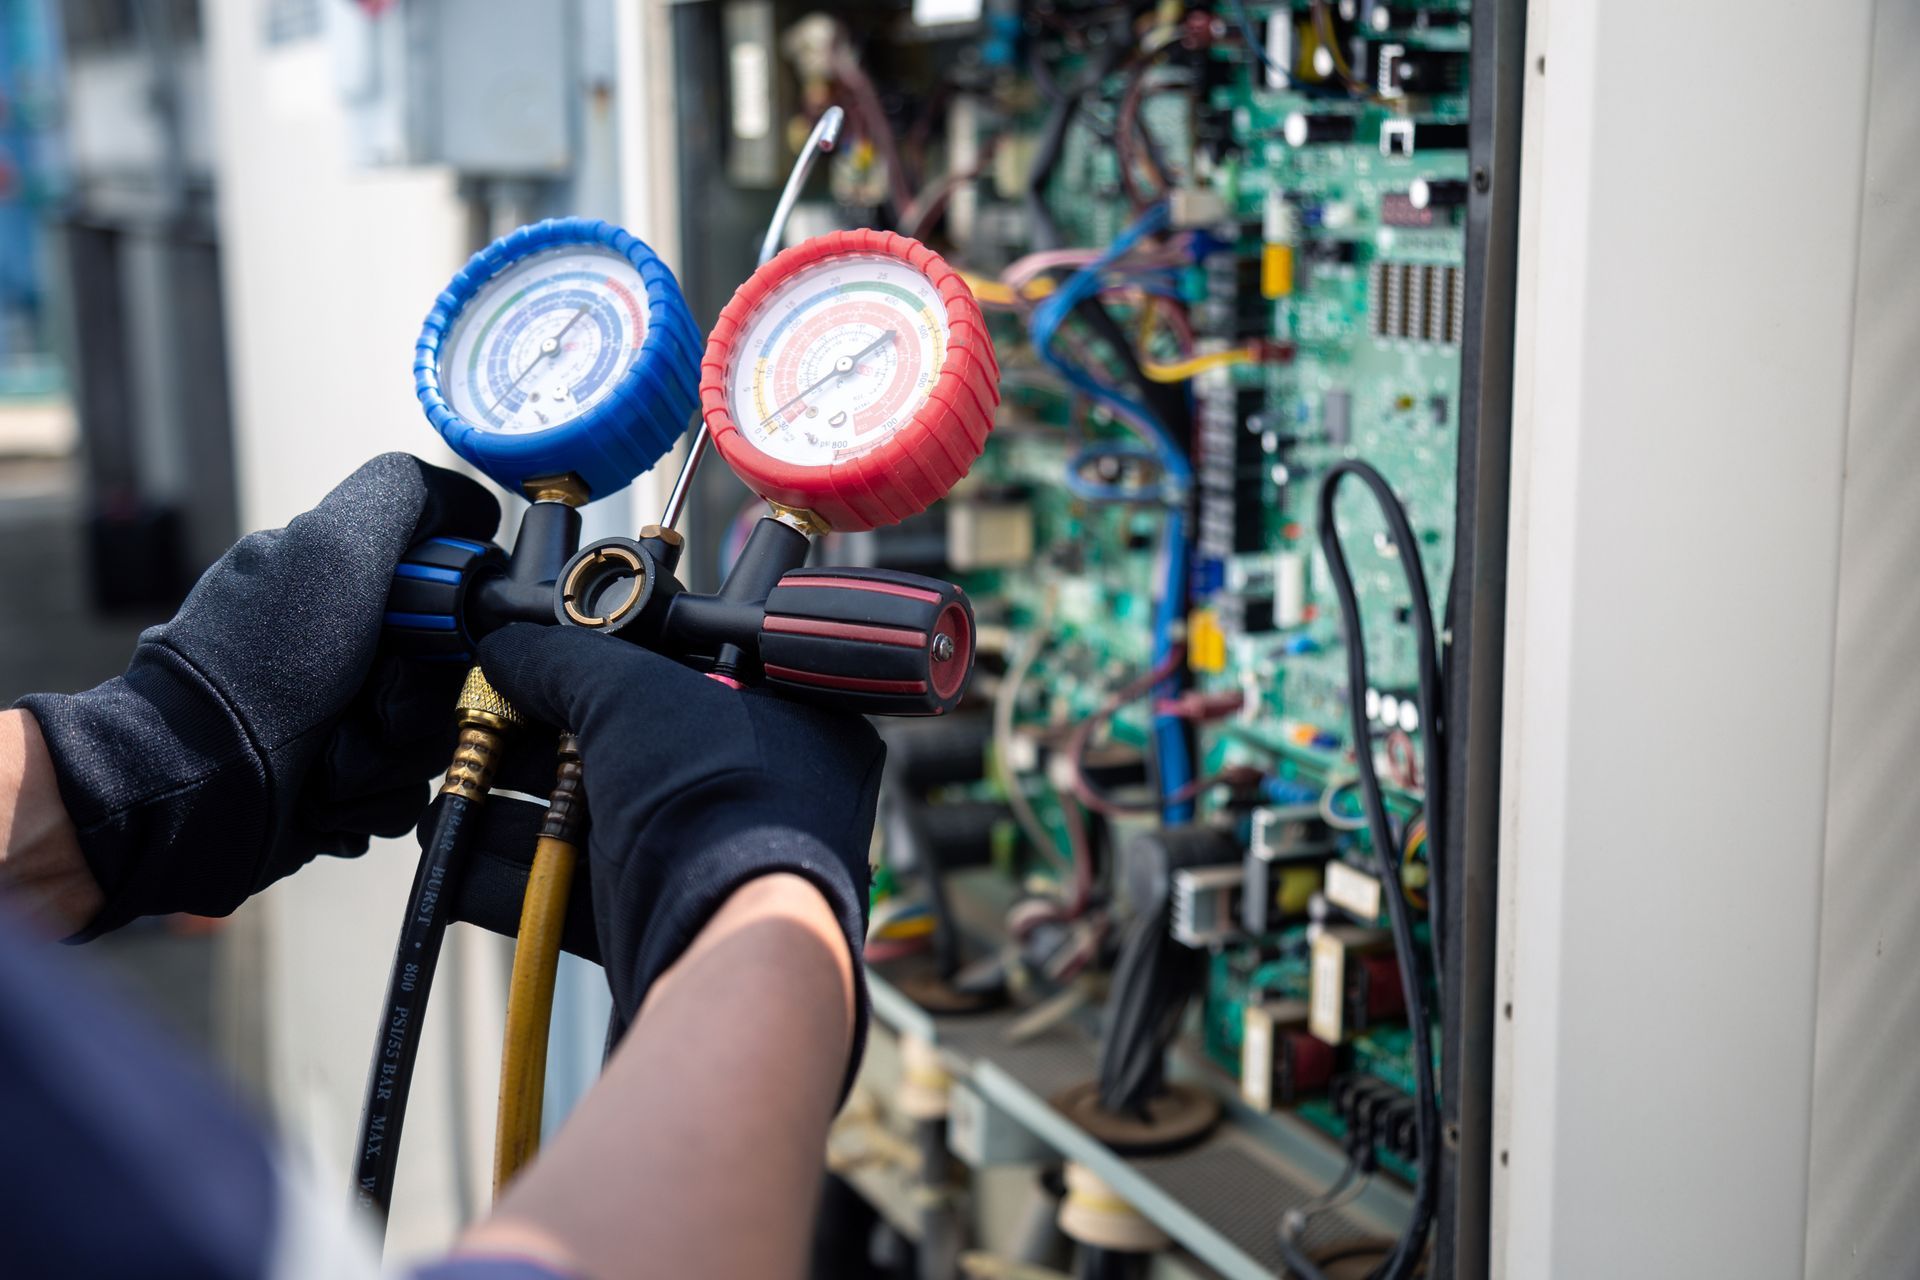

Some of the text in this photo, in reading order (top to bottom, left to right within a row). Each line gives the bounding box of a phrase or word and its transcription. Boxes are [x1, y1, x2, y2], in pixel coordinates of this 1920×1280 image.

[877, 272, 888, 280] 25
[919, 324, 929, 339] 500
[754, 338, 763, 348] 10
[765, 364, 773, 378] 100
[918, 371, 928, 387] 600
[882, 417, 898, 431] 700
[831, 440, 848, 449] 800
[440, 814, 462, 850] BAR
[418, 865, 446, 926] BURST
[401, 962, 419, 992] 800
[386, 1005, 408, 1060] PSI/55
[376, 1062, 398, 1100] BAR
[366, 1115, 387, 1160] MAX.
